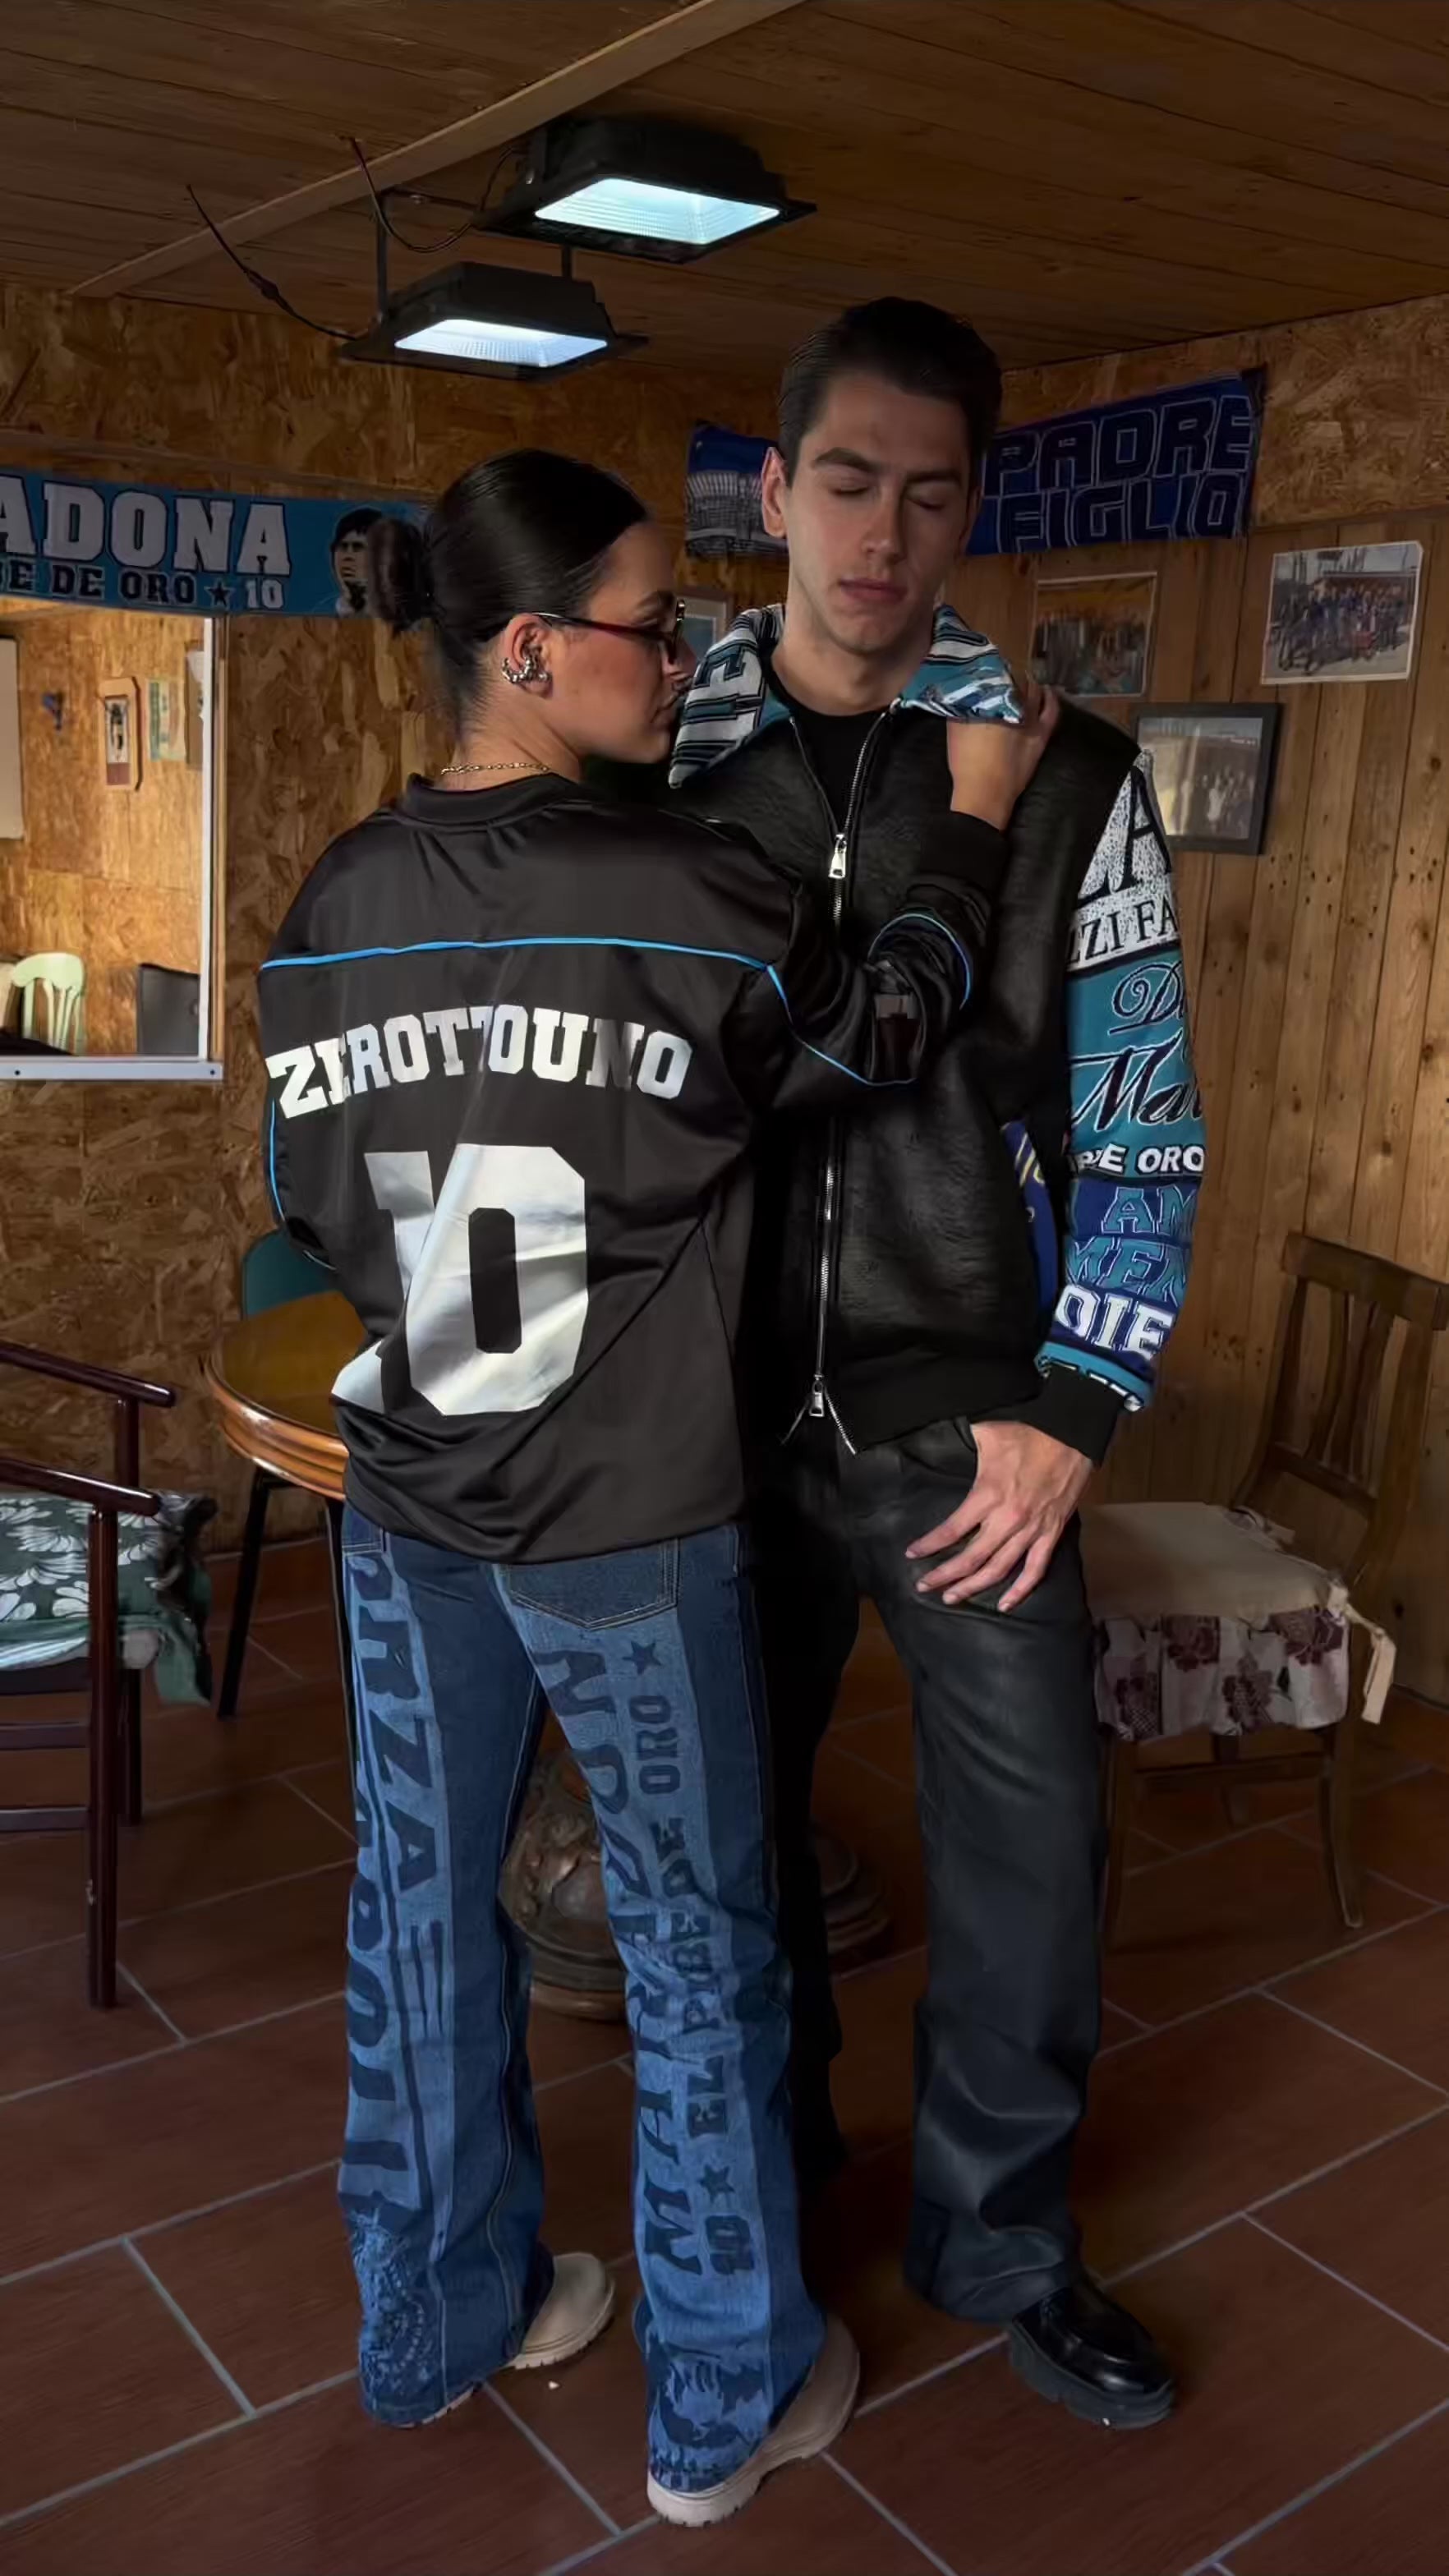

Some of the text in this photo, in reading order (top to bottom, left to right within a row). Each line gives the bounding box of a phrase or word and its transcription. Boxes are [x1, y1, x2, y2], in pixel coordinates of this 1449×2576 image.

[983, 395, 1253, 497] PADRE
[0, 476, 291, 577] ADONA
[51, 564, 104, 596] DE
[120, 571, 195, 605] ORO
[246, 579, 284, 609] 10
[1136, 1145, 1206, 1173] ORO
[331, 1143, 588, 1415] 10
[629, 1695, 681, 1795] ORO
